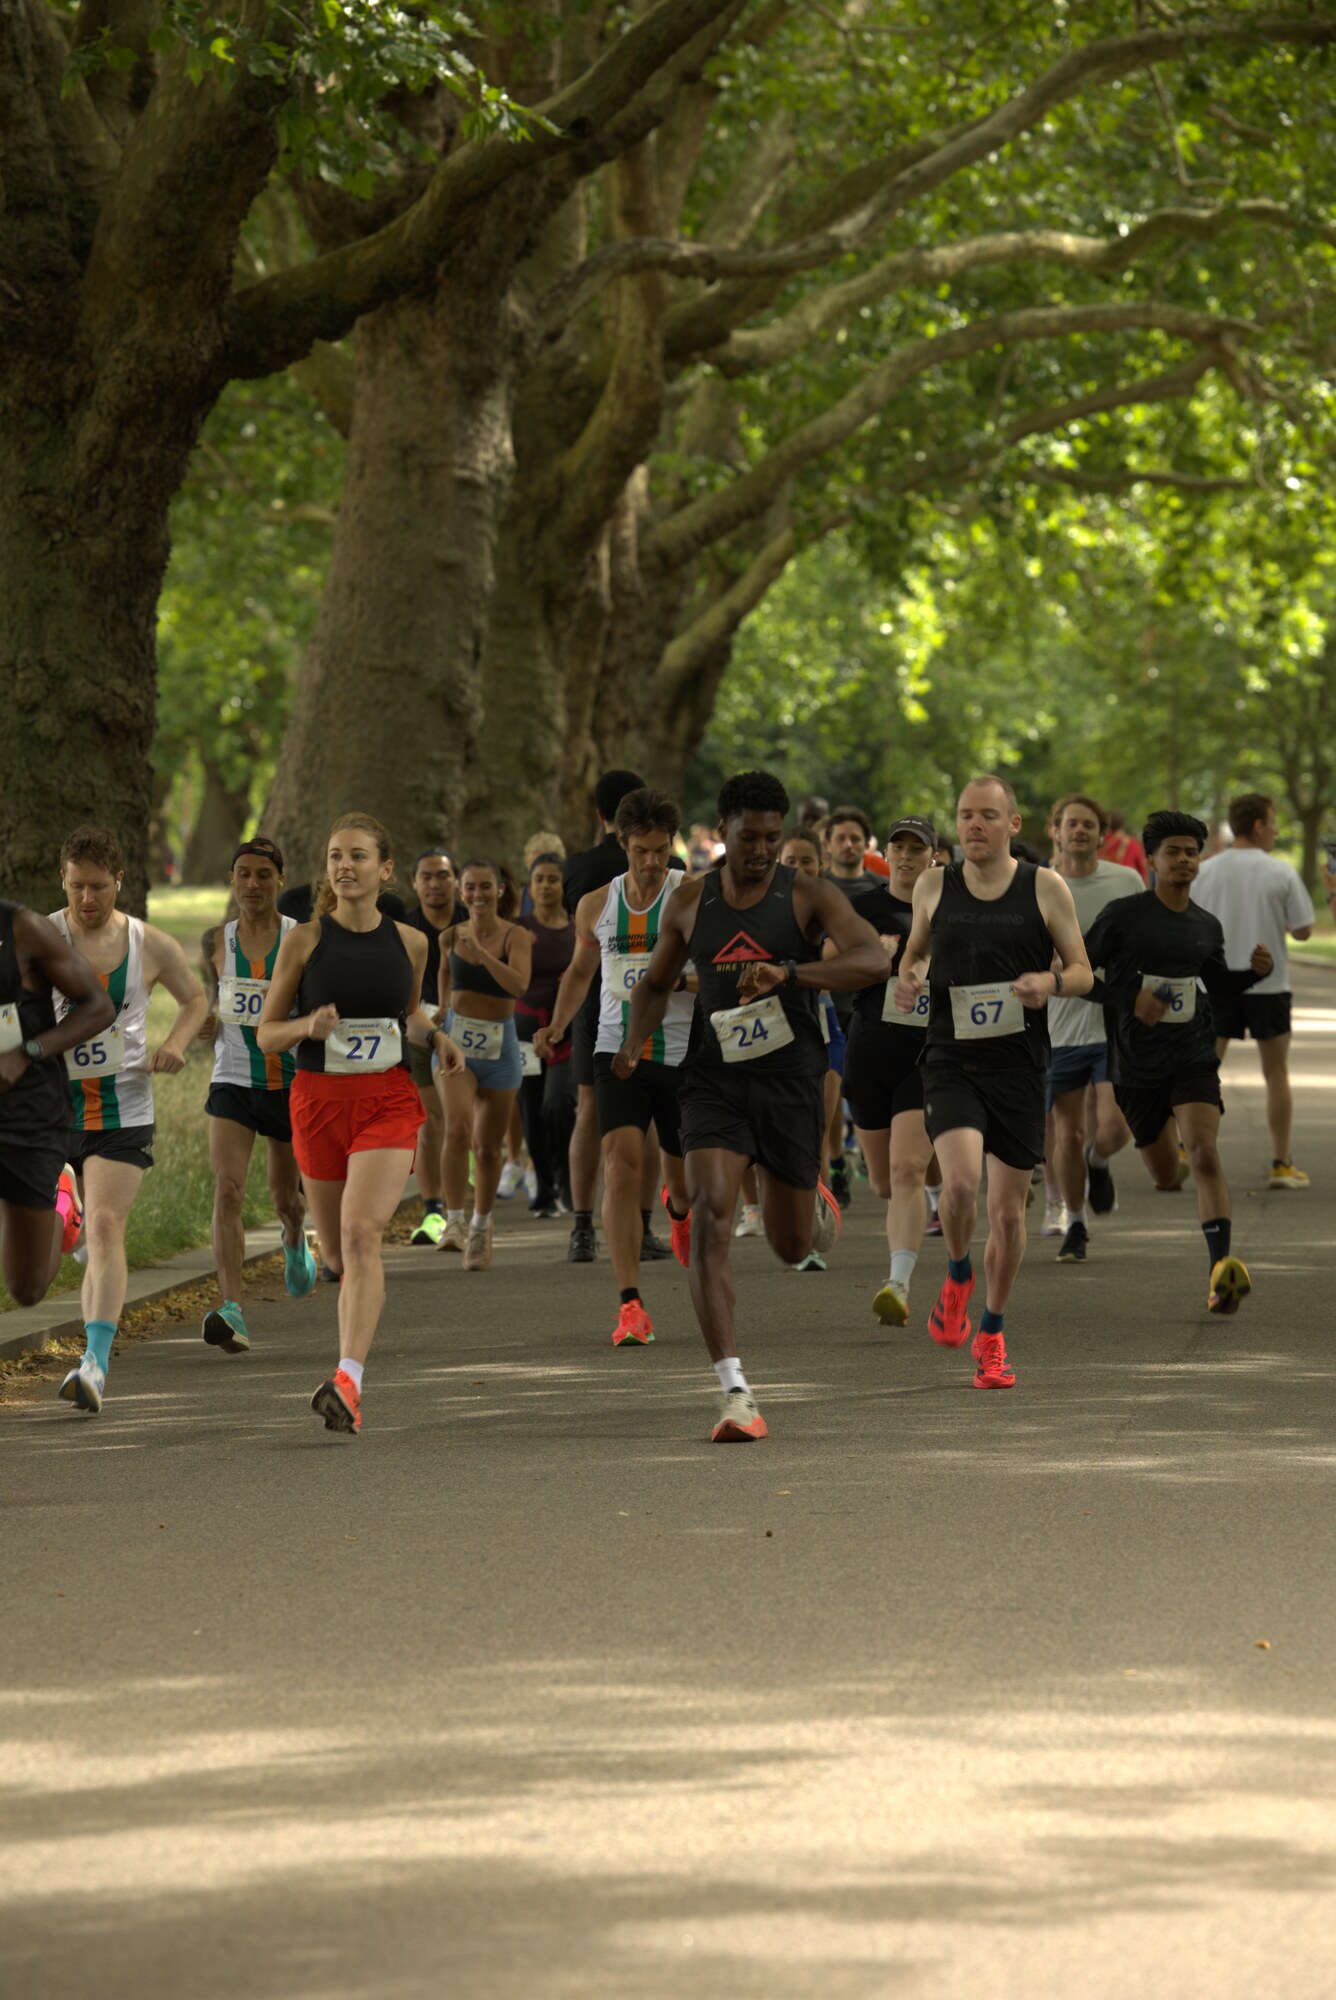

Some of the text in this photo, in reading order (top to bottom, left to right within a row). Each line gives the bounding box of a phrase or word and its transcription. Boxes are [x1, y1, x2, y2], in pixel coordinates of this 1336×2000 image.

[716, 964, 737, 972] NIKE
[233, 992, 262, 1015] 30
[911, 994, 930, 1015] 8
[971, 1000, 1003, 1025] 67
[462, 1030, 487, 1050] 52
[732, 1018, 768, 1048] 24
[73, 1041, 107, 1067] 65
[346, 1036, 381, 1060] 27
